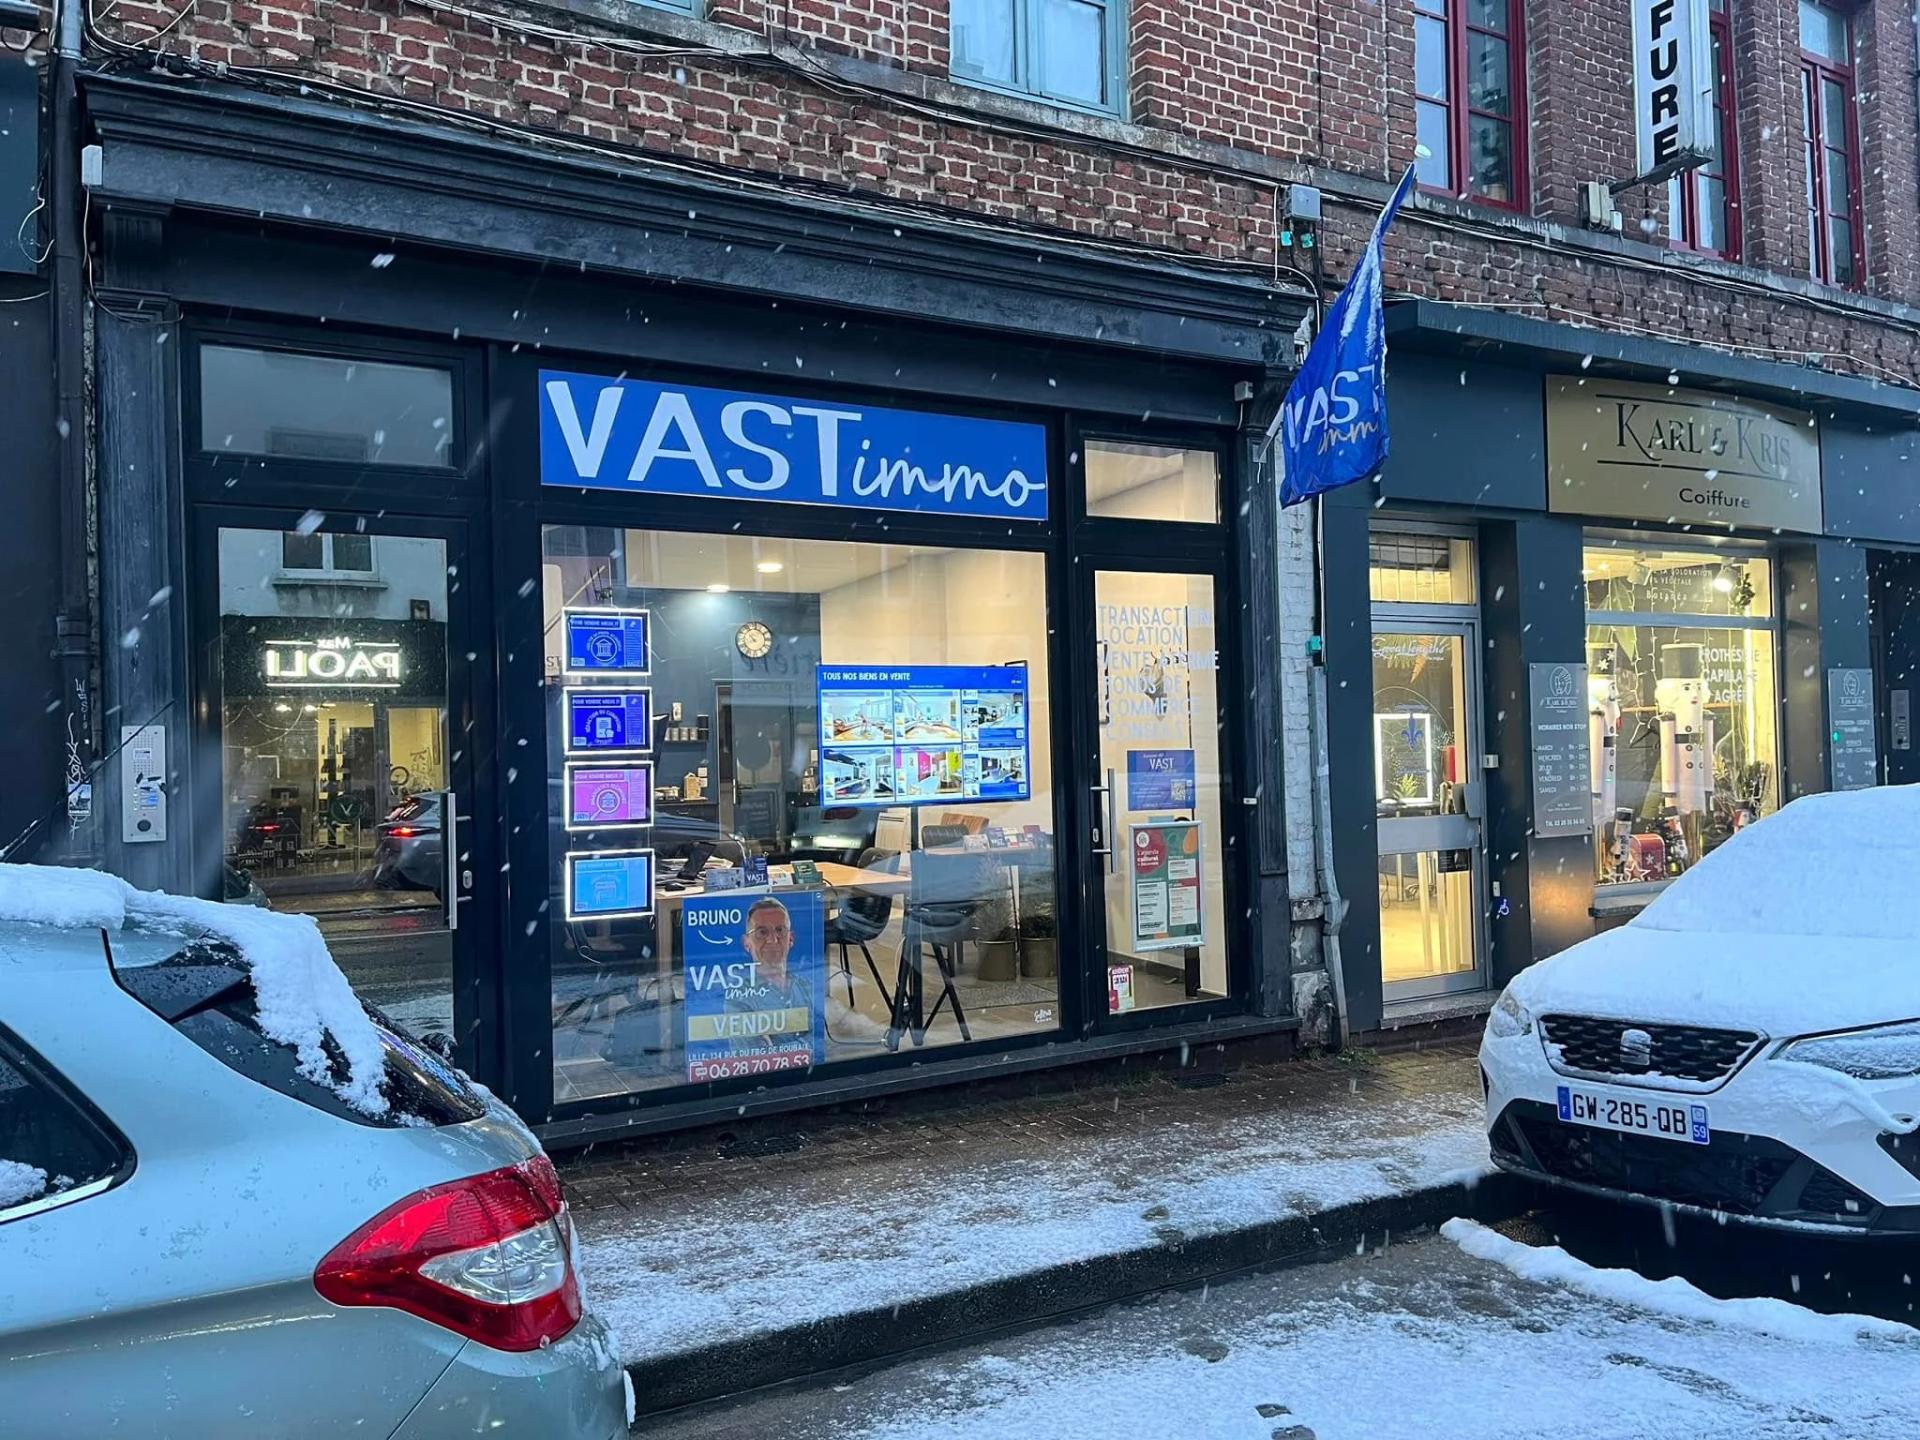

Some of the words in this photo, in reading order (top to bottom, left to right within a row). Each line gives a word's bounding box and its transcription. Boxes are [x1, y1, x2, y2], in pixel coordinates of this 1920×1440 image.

[1650, 0, 1679, 166] FURE
[1285, 364, 1379, 449] VAST
[1616, 402, 1703, 462] KARL
[1735, 416, 1792, 474] KRIS
[1678, 487, 1752, 509] Coiffure
[1100, 626, 1184, 645] LOCATION
[1697, 645, 1761, 663] PROTHÉSE
[823, 672, 841, 681] TOUS
[843, 672, 858, 681] NOS
[858, 672, 879, 681] BIENS
[879, 672, 889, 681] EN
[890, 672, 911, 681] VENTE
[1702, 668, 1760, 684] CAPILLAE
[1714, 685, 1748, 703] AGRÉ
[1149, 757, 1175, 770] VAST
[687, 908, 742, 927] BRUNO
[689, 961, 761, 991] VAST
[712, 1010, 787, 1037] VENDU
[709, 1063, 730, 1079] 06
[732, 1061, 749, 1076] 28
[752, 1059, 770, 1073] 70
[773, 1057, 790, 1069] 78
[1572, 1094, 1687, 1135] GW-285-QB
[1693, 1125, 1707, 1139] 59
